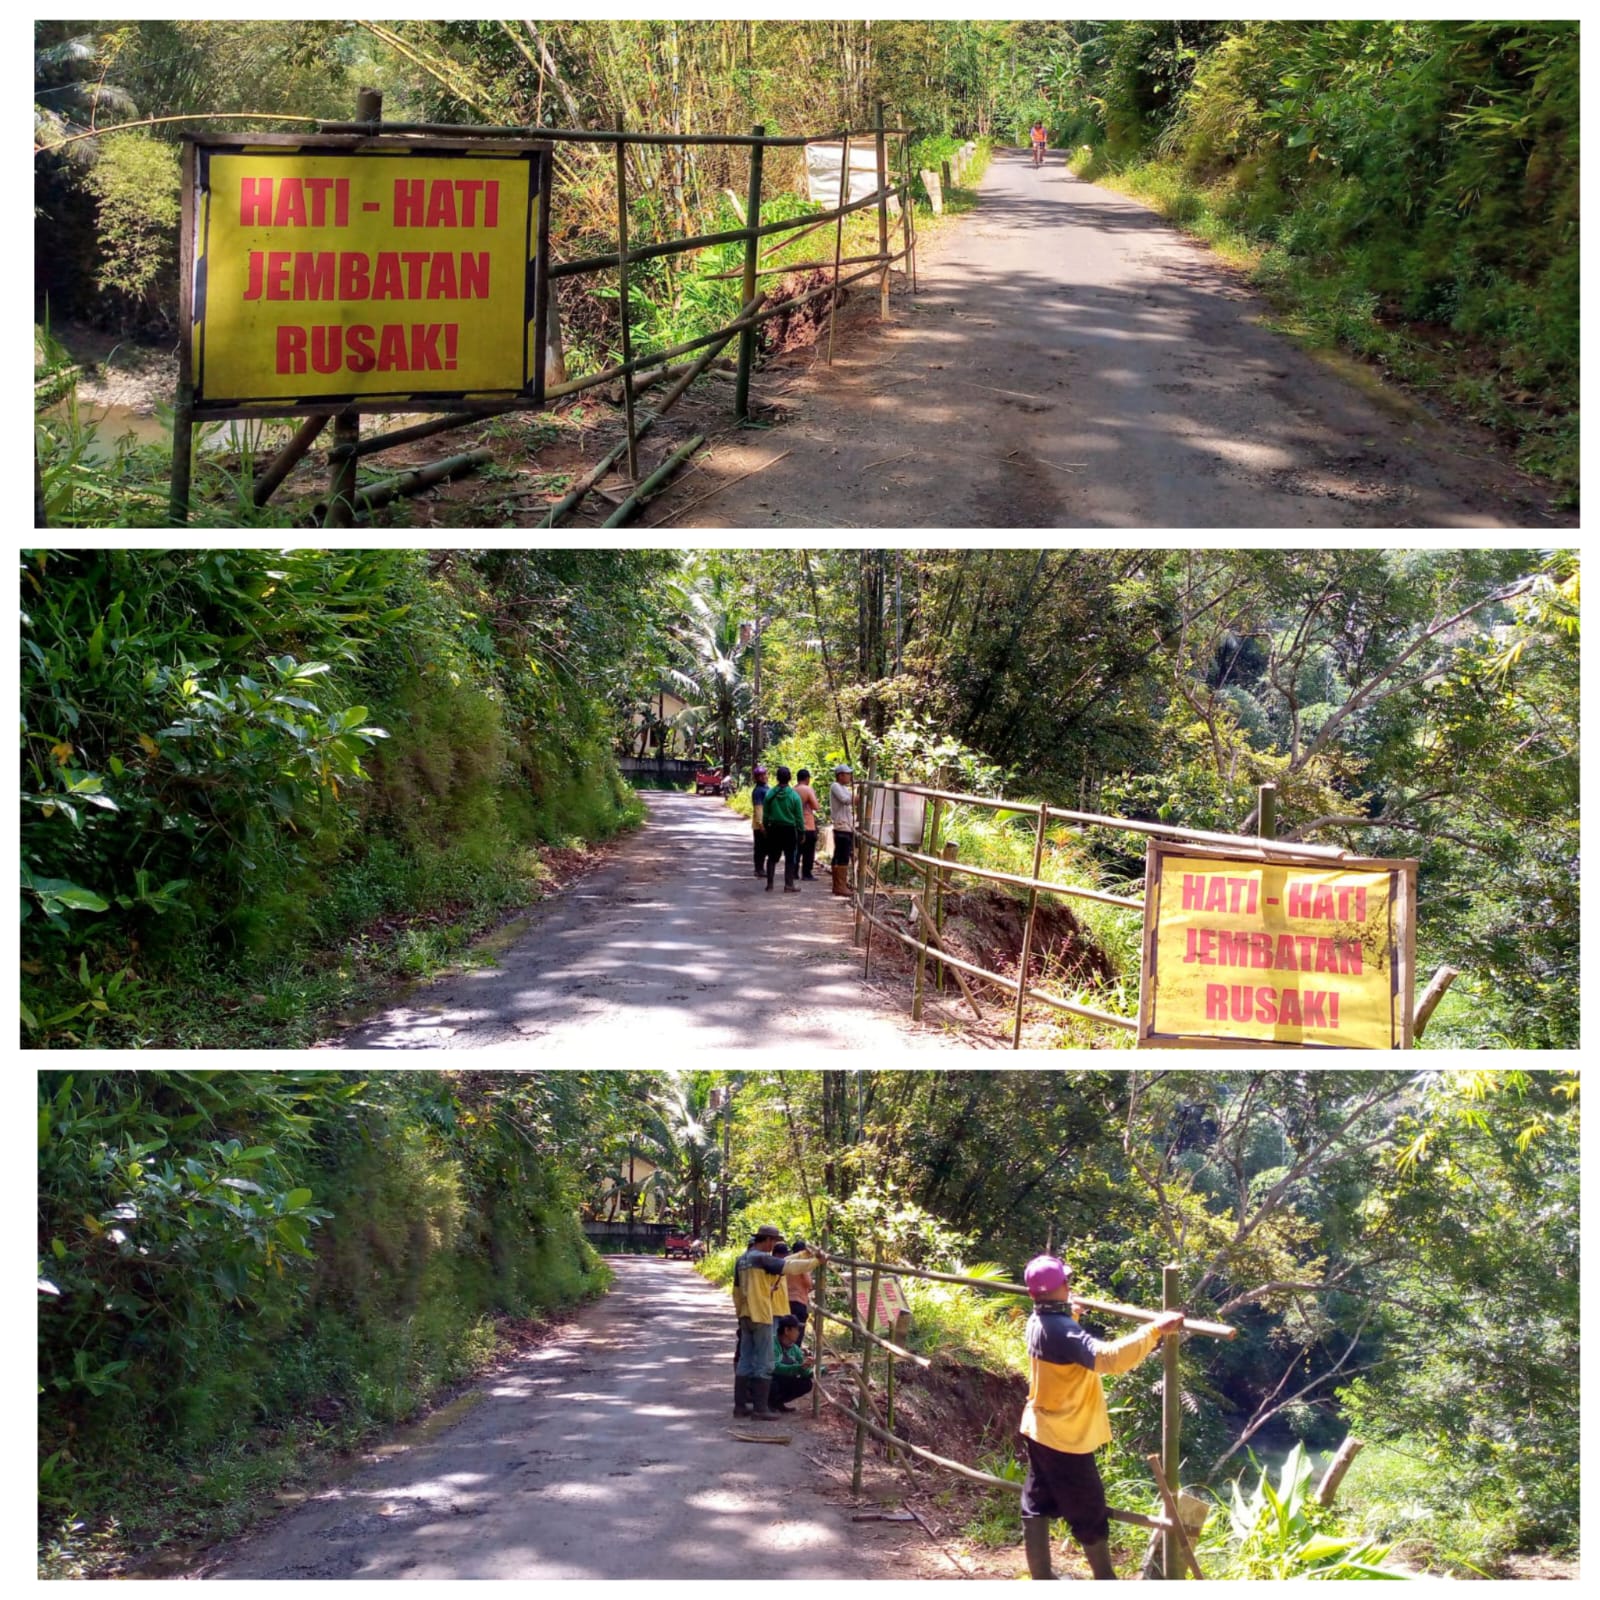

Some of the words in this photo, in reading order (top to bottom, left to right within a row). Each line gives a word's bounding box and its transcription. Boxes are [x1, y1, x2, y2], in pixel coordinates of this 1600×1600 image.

[240, 177, 350, 227] HATI
[394, 179, 499, 227] HATI
[244, 251, 490, 300] JEMBATAN
[277, 323, 458, 374] RUSAK!
[1183, 875, 1257, 914] HATI
[1288, 884, 1366, 922] HATI
[1184, 928, 1363, 975] JEMBATAN
[1206, 984, 1339, 1028] RUSAK!
